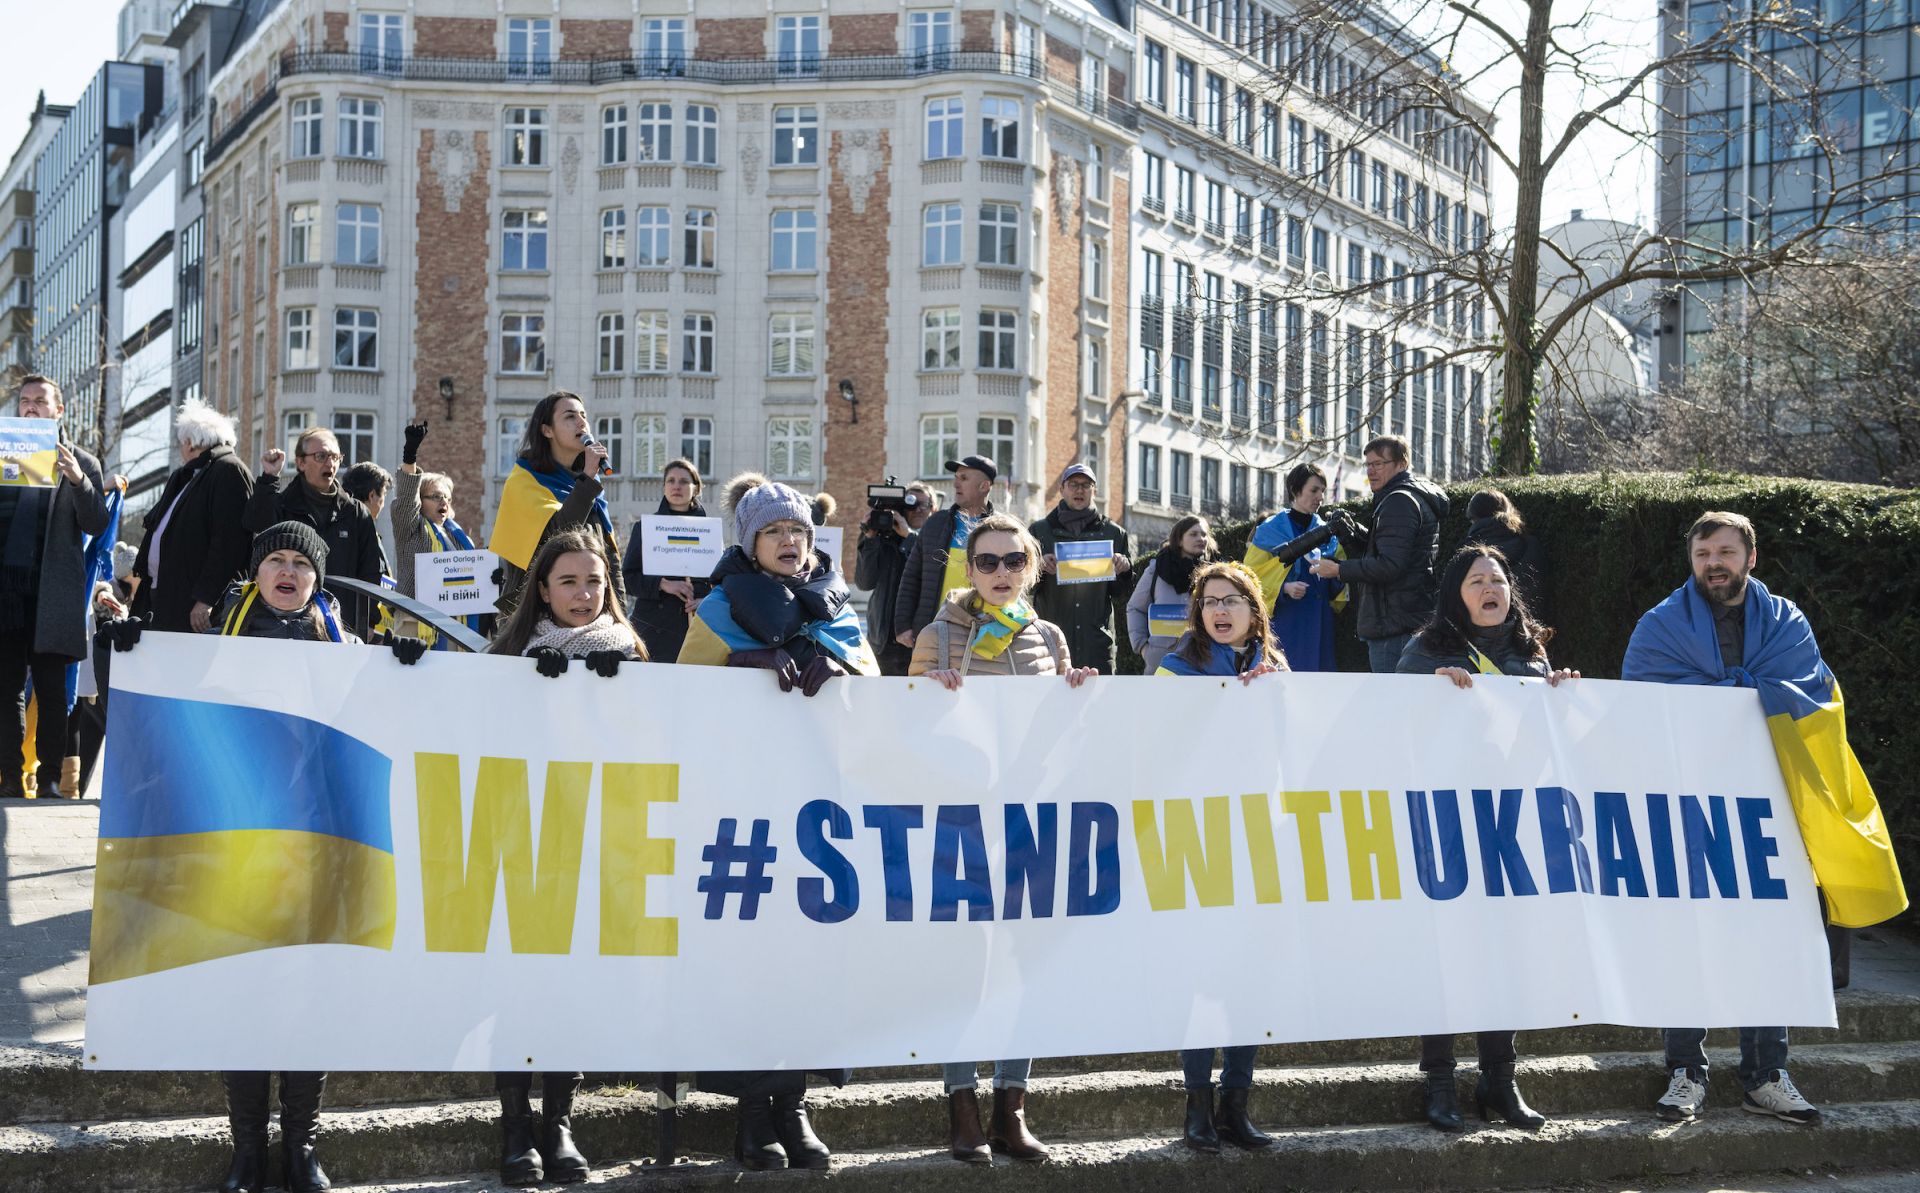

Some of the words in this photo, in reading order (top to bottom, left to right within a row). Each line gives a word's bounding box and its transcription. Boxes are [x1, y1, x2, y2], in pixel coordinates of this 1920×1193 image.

[13, 442, 39, 452] YOUR
[655, 525, 711, 534] #StandWithUkraine
[653, 545, 715, 555] #Together4Freedom
[433, 556, 451, 564] Geen
[453, 555, 475, 563] Oorlog
[444, 566, 474, 574] Oekraine
[452, 588, 480, 601] війні
[414, 751, 679, 956] WE
[697, 786, 1788, 924] #STANDWITHUKRAINE
